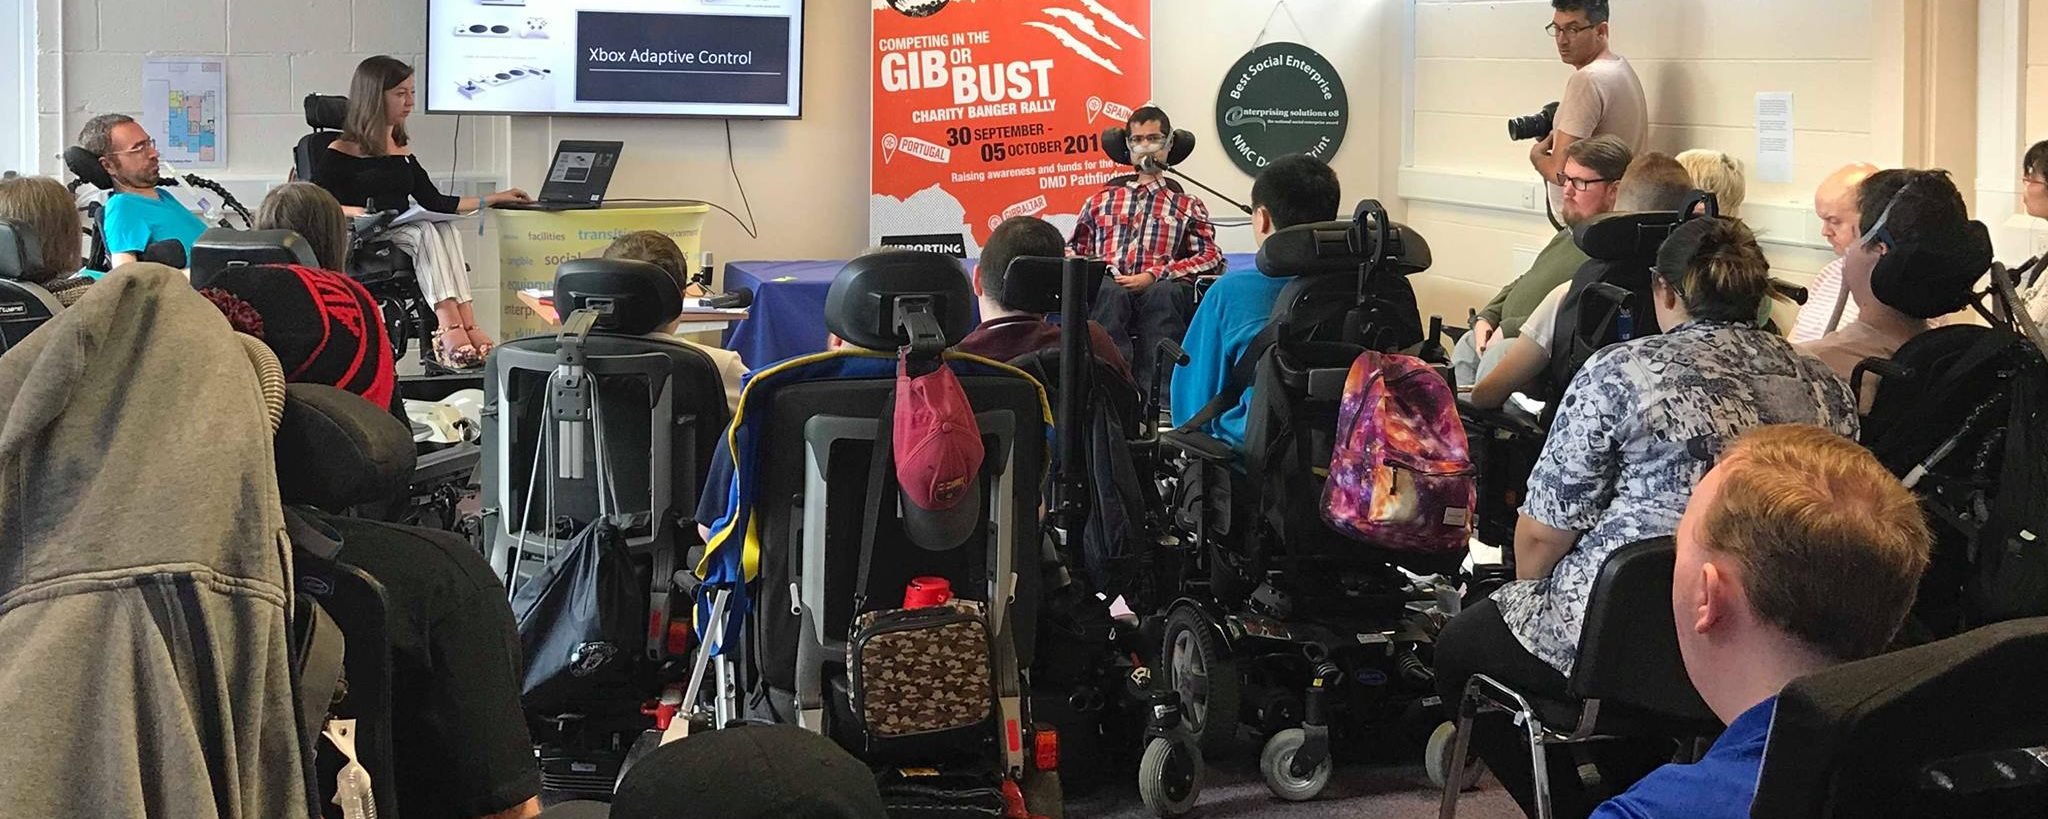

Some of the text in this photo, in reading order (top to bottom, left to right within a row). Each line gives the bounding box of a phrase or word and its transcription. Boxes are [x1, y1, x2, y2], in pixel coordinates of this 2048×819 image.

[879, 31, 990, 51] COMPETING IN THE
[589, 48, 752, 65] Xbox Adaptive Control
[951, 48, 972, 65] OR
[881, 51, 948, 91] GIB
[952, 60, 1054, 104] BUST
[1230, 55, 1333, 101] Best Social Enterprise
[912, 99, 1056, 124] CHARITY BANGER RALLY
[1105, 103, 1132, 119] SPAIN
[1290, 108, 1327, 117] solutions
[1328, 109, 1340, 117] 08
[947, 127, 972, 147] 30
[974, 123, 1044, 141] SEPTEMBER
[900, 139, 946, 161] PORTUGAL
[981, 134, 1098, 162] 05 OCTOBER 201
[1232, 133, 1257, 161] NMC
[951, 171, 985, 184] Raising
[987, 166, 1036, 180] awareness
[1038, 163, 1055, 175] and
[1056, 160, 1083, 174] funds
[1084, 160, 1097, 170] for
[1099, 158, 1114, 169] the
[1039, 170, 1136, 189] DMD Pathfind
[1003, 196, 1045, 219] GIBRALTAR
[528, 231, 565, 241] facilities
